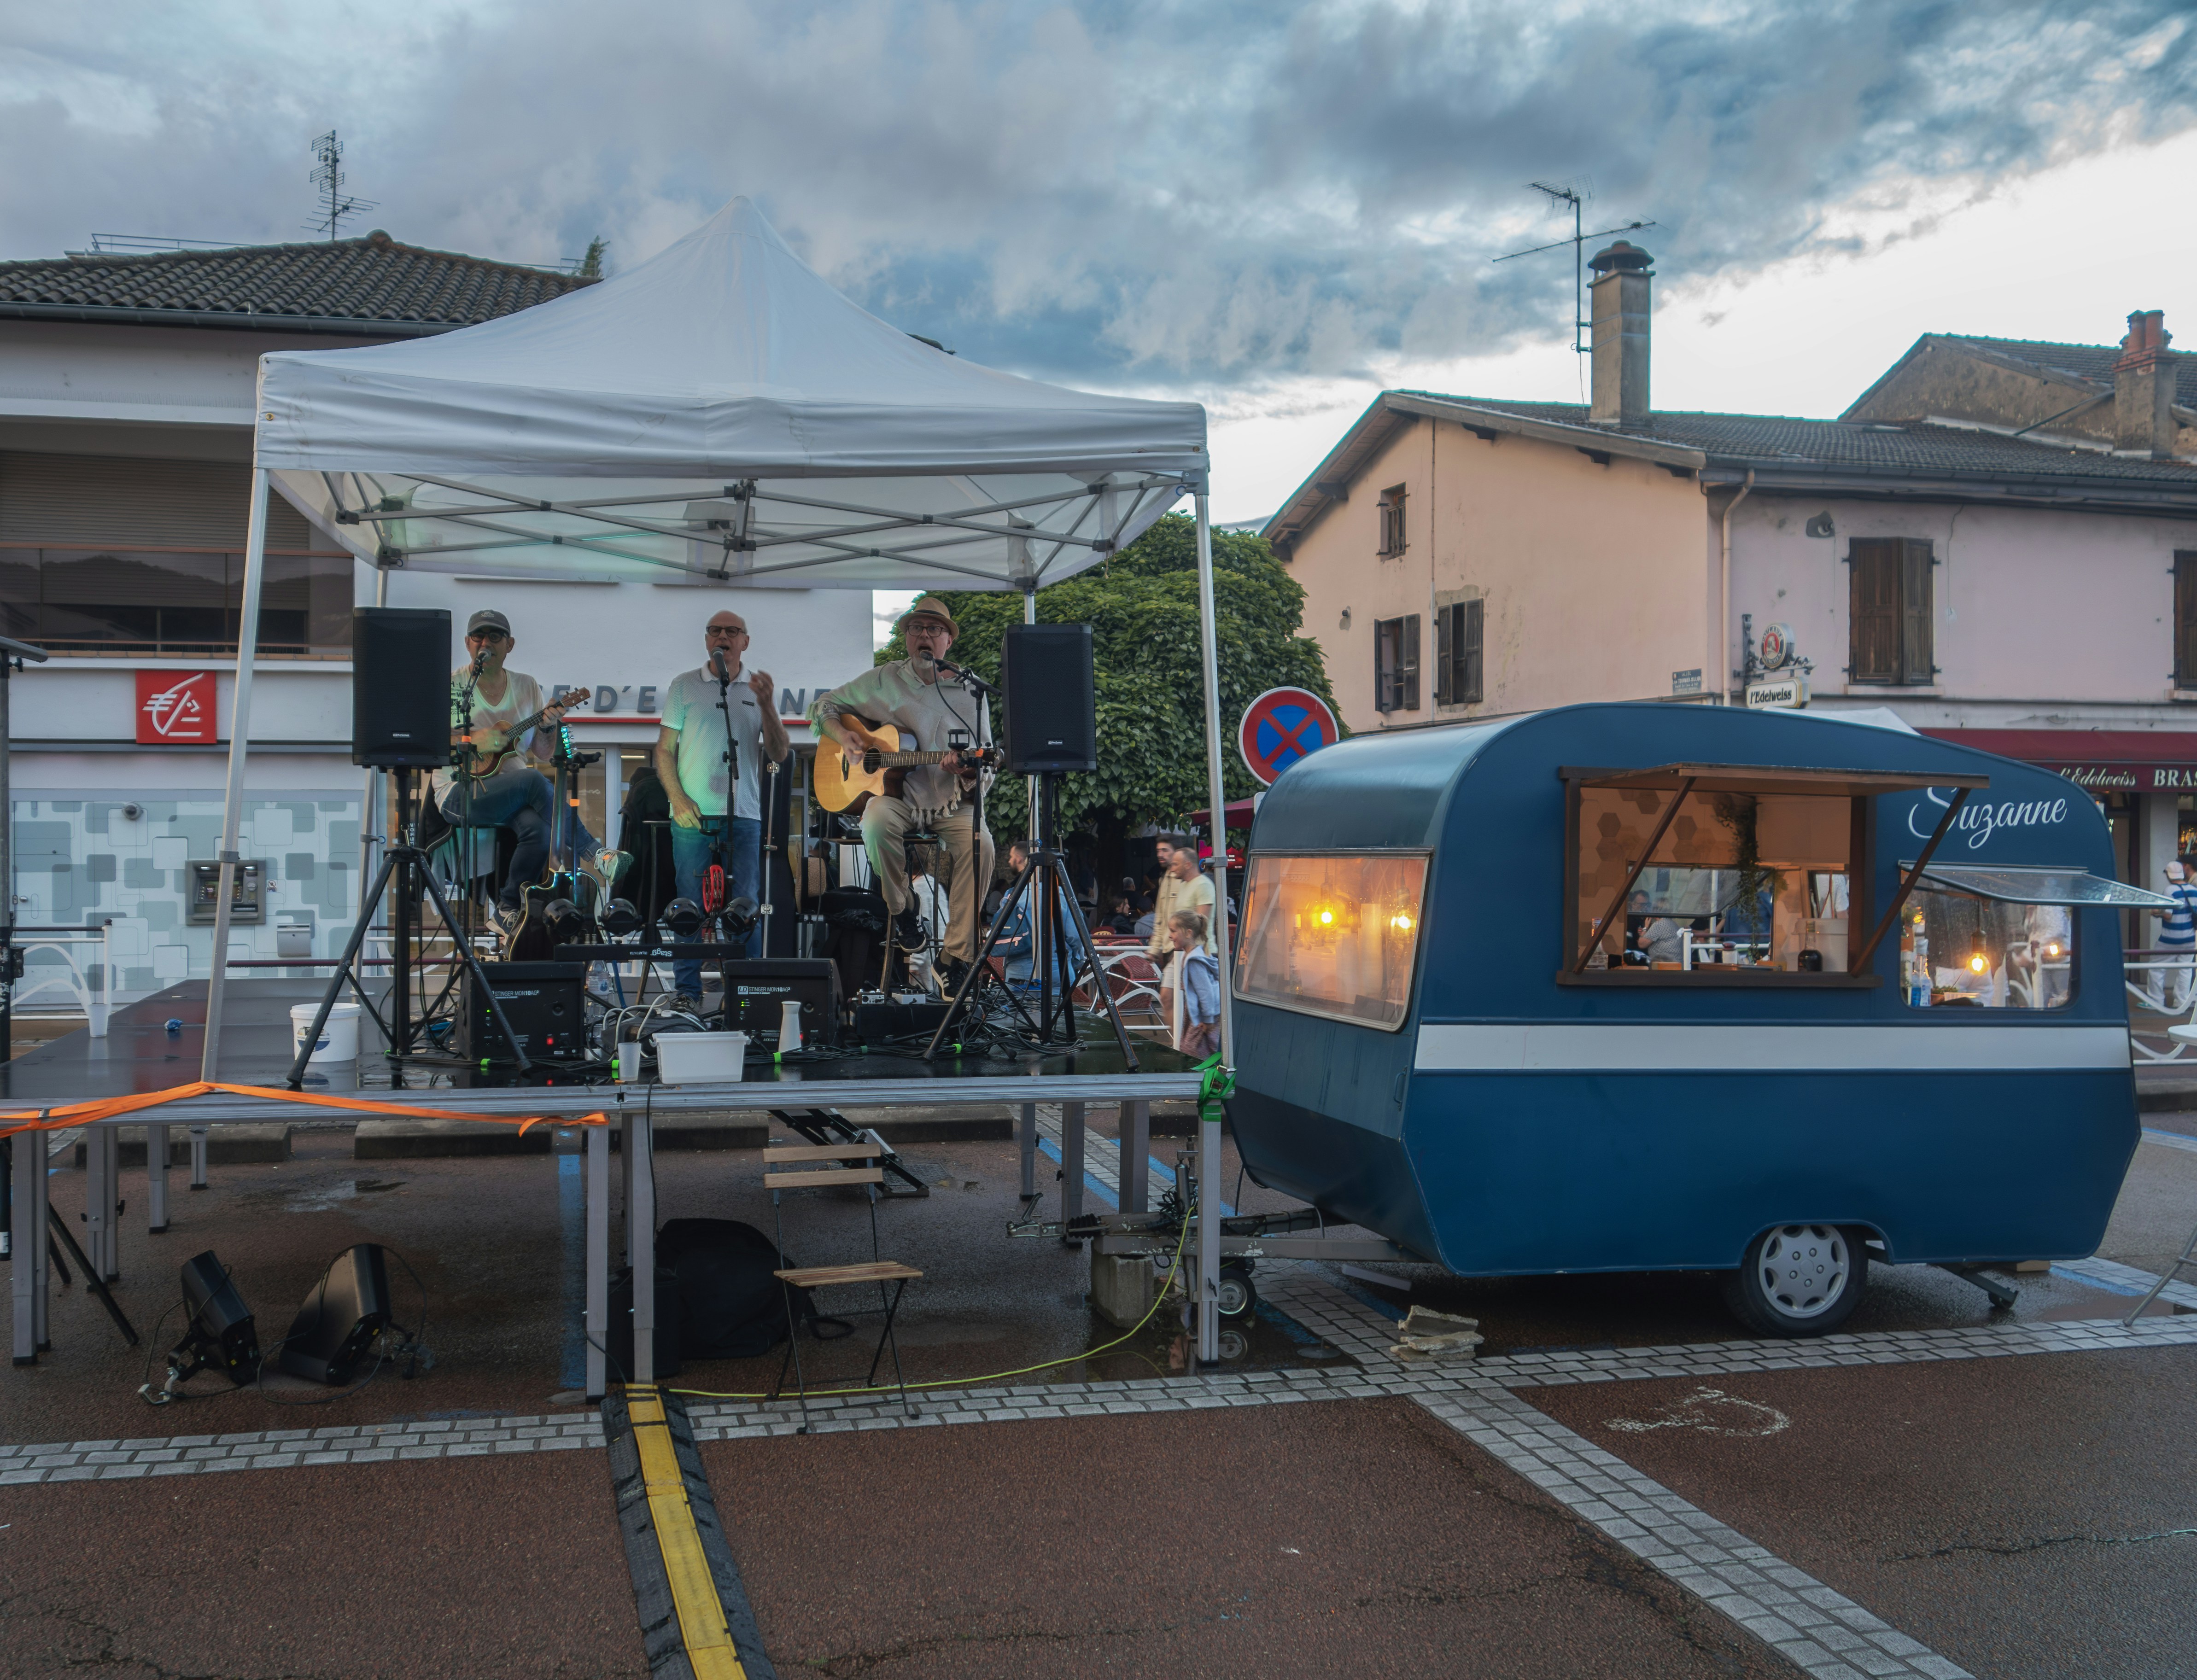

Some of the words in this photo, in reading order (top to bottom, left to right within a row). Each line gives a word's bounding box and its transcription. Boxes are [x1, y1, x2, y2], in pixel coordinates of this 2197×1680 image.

[1750, 687, 1792, 704] l'Edelweiss
[1908, 787, 2068, 849] Suzanne
[652, 948, 672, 957] Stagg
